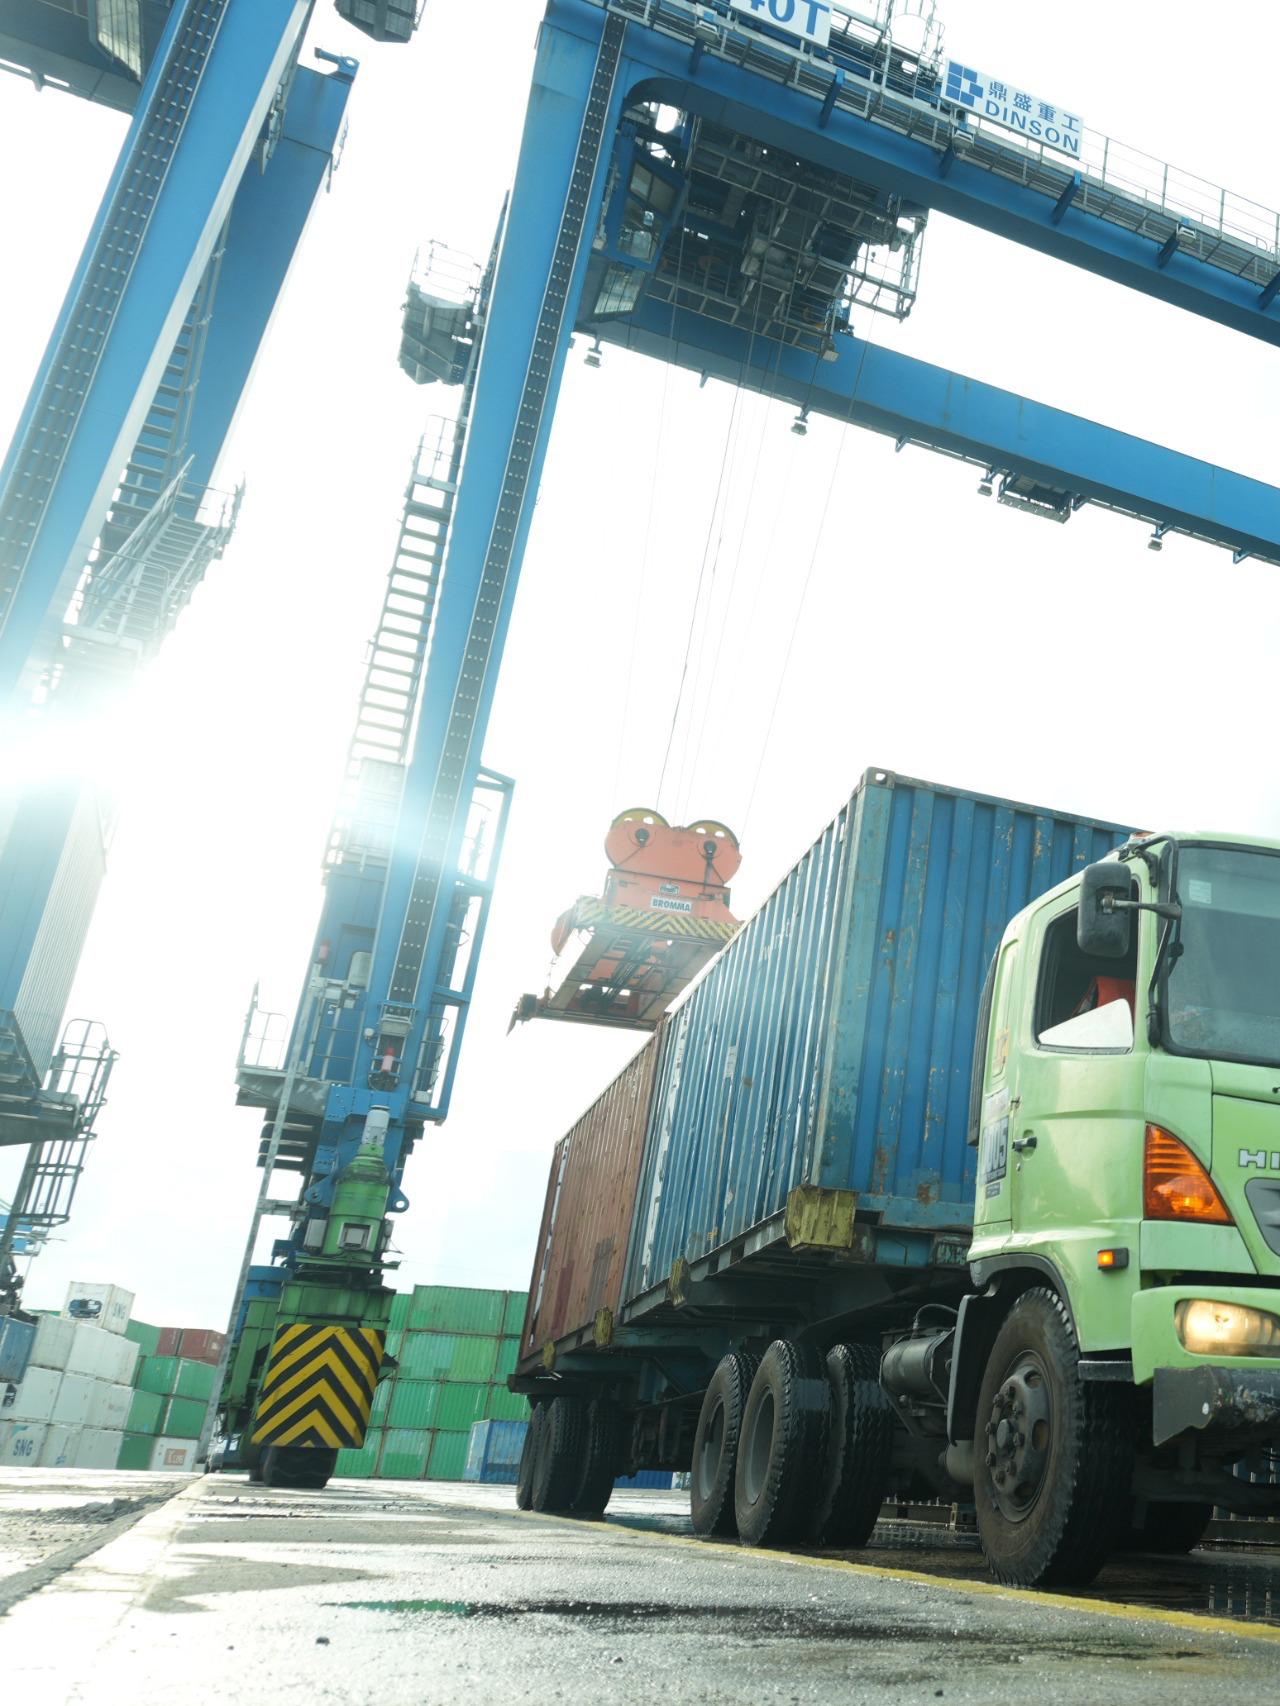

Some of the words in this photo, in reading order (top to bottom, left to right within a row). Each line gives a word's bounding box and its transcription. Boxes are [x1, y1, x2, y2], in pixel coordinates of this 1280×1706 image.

[989, 81, 1080, 133] 鼎盛重工
[985, 99, 1079, 153] DINSON
[652, 898, 691, 912] BROMMA
[13, 1438, 34, 1457] SNG
